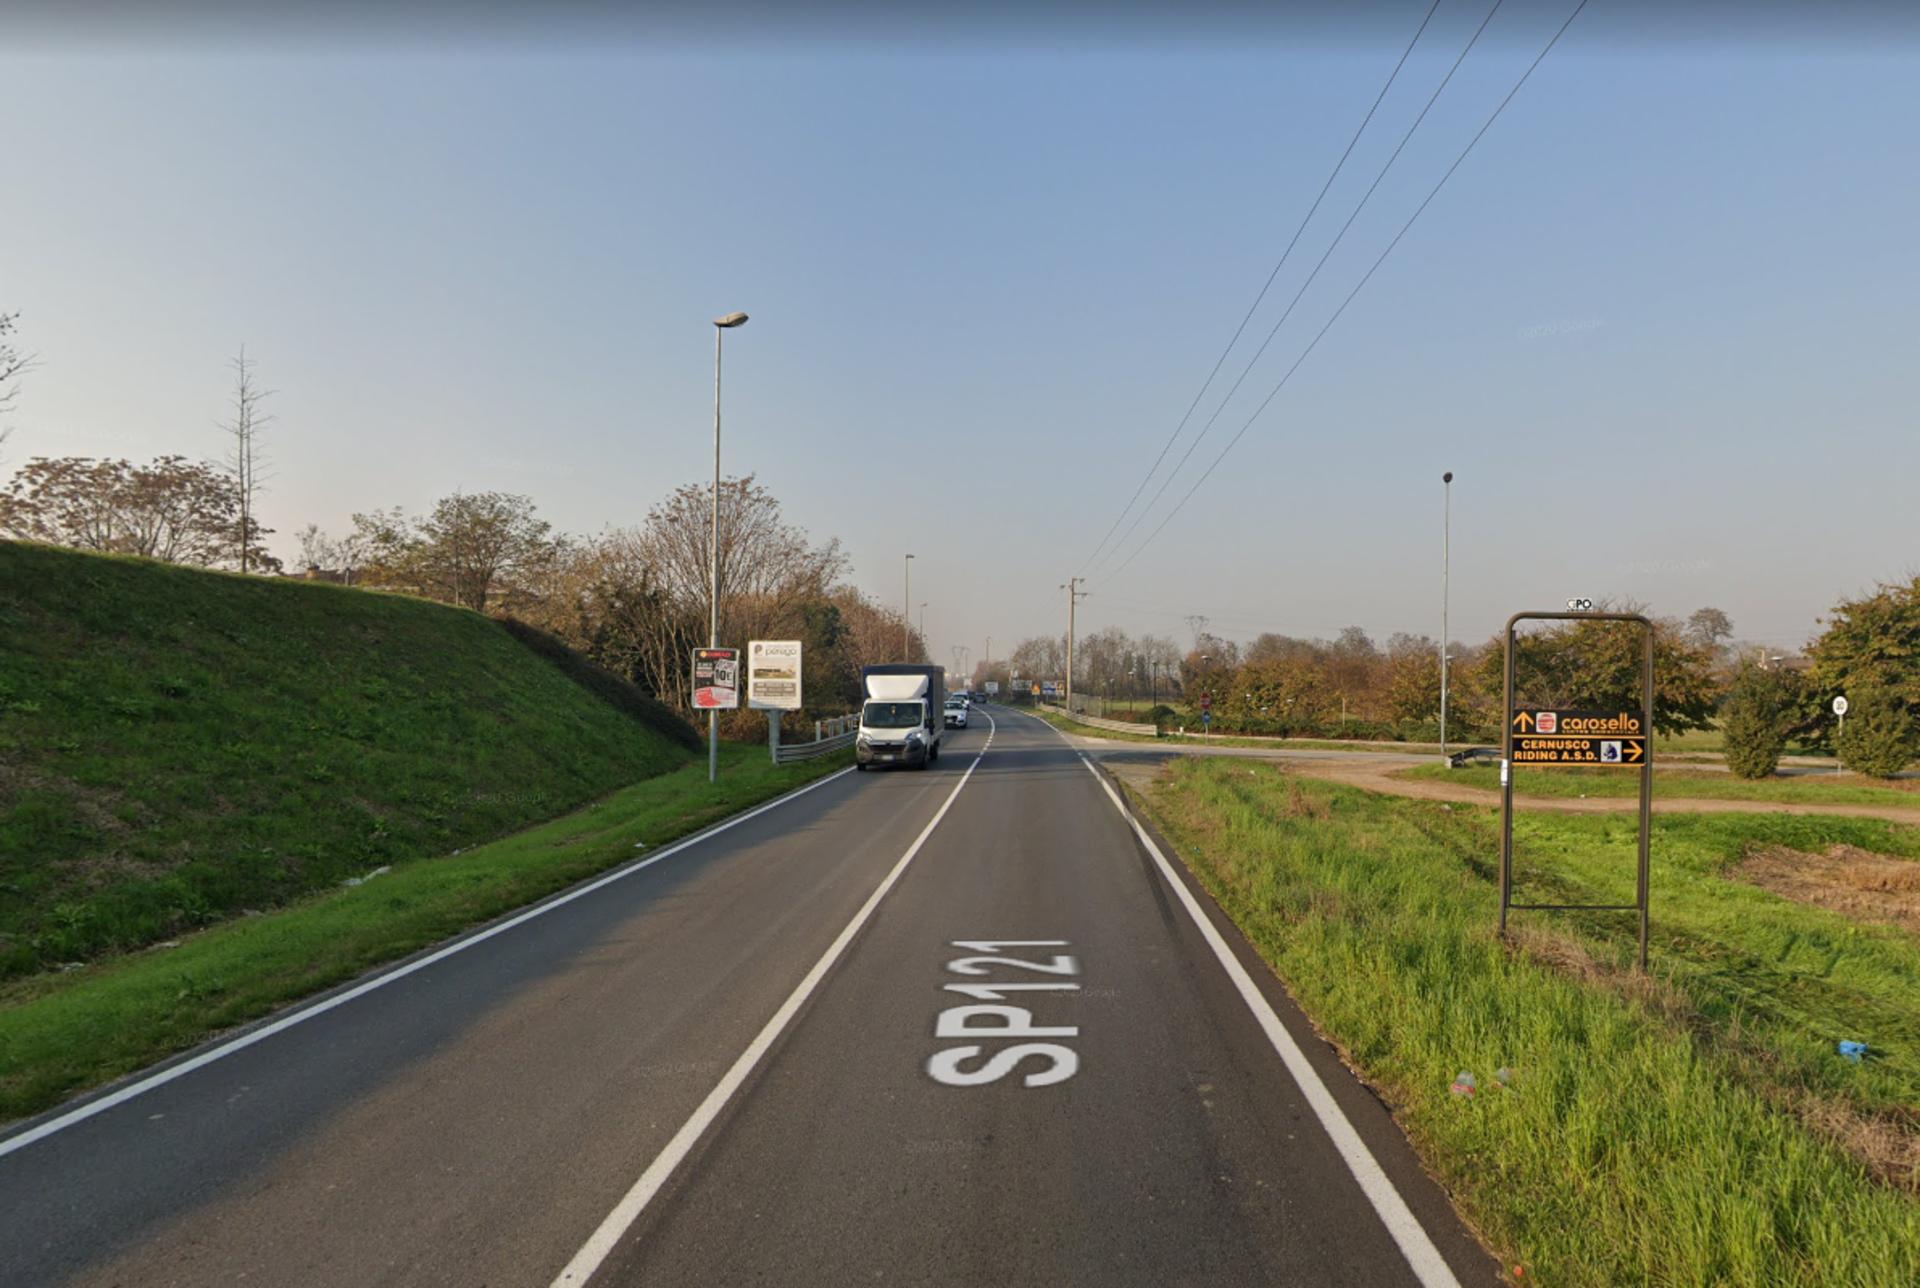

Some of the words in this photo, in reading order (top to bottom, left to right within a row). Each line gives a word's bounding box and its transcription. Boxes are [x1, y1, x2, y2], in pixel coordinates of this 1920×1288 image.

[1561, 712, 1639, 730] carosello
[1521, 740, 1590, 750] CERNUSCO
[1514, 751, 1557, 761] RIDING
[1561, 751, 1597, 761] A.S.D.
